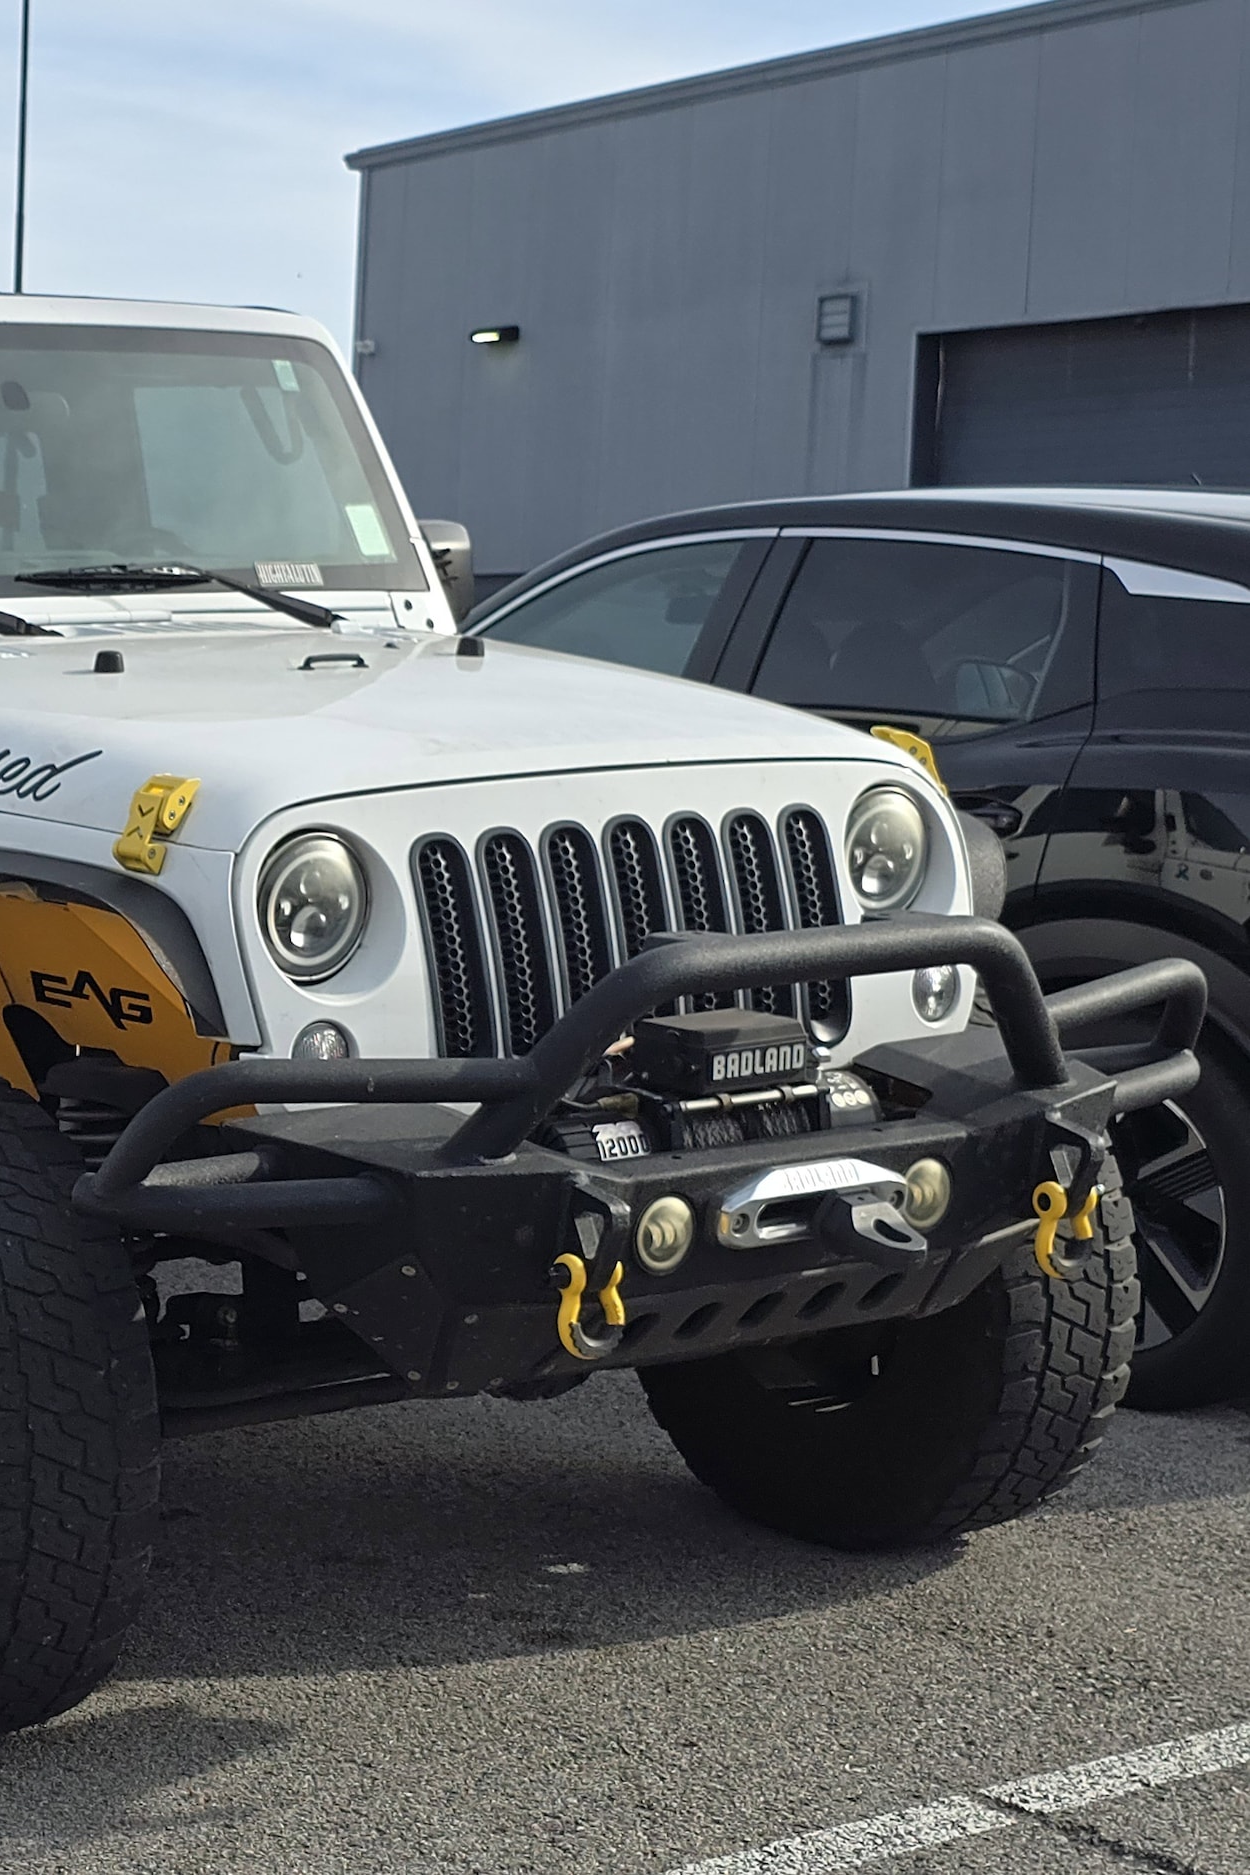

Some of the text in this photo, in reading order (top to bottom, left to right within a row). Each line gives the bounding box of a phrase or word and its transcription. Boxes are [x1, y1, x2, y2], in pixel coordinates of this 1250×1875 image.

[30, 970, 153, 1031] EAG
[712, 1044, 804, 1081] BADLAND
[599, 1134, 650, 1159] 12000
